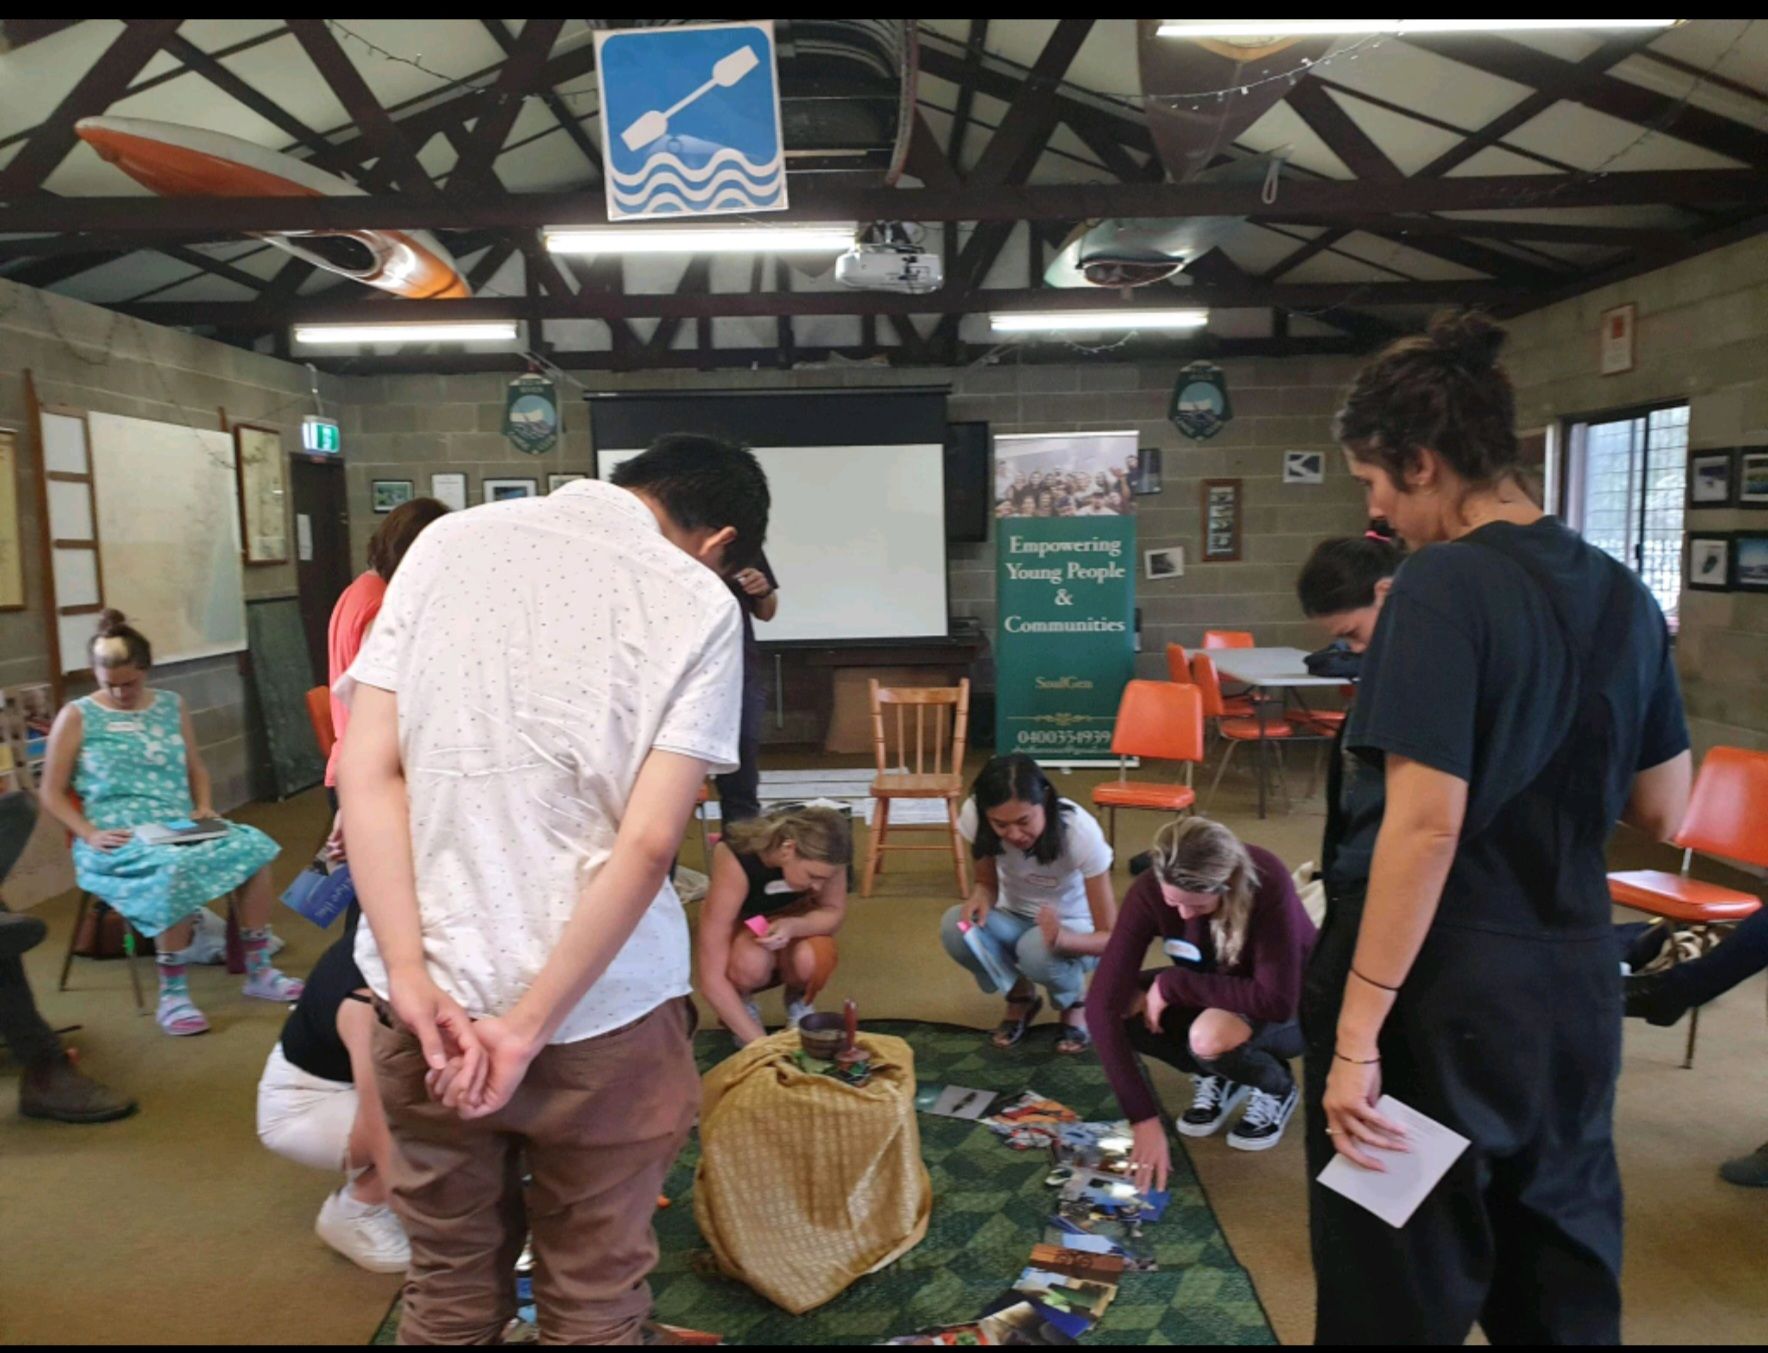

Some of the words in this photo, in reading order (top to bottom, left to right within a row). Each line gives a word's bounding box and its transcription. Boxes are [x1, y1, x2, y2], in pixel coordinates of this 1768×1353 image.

[1010, 535, 1121, 558] Empowering
[1005, 562, 1062, 584] Young
[1067, 561, 1126, 584] People
[1054, 588, 1073, 606] &
[1004, 615, 1126, 633] Communities
